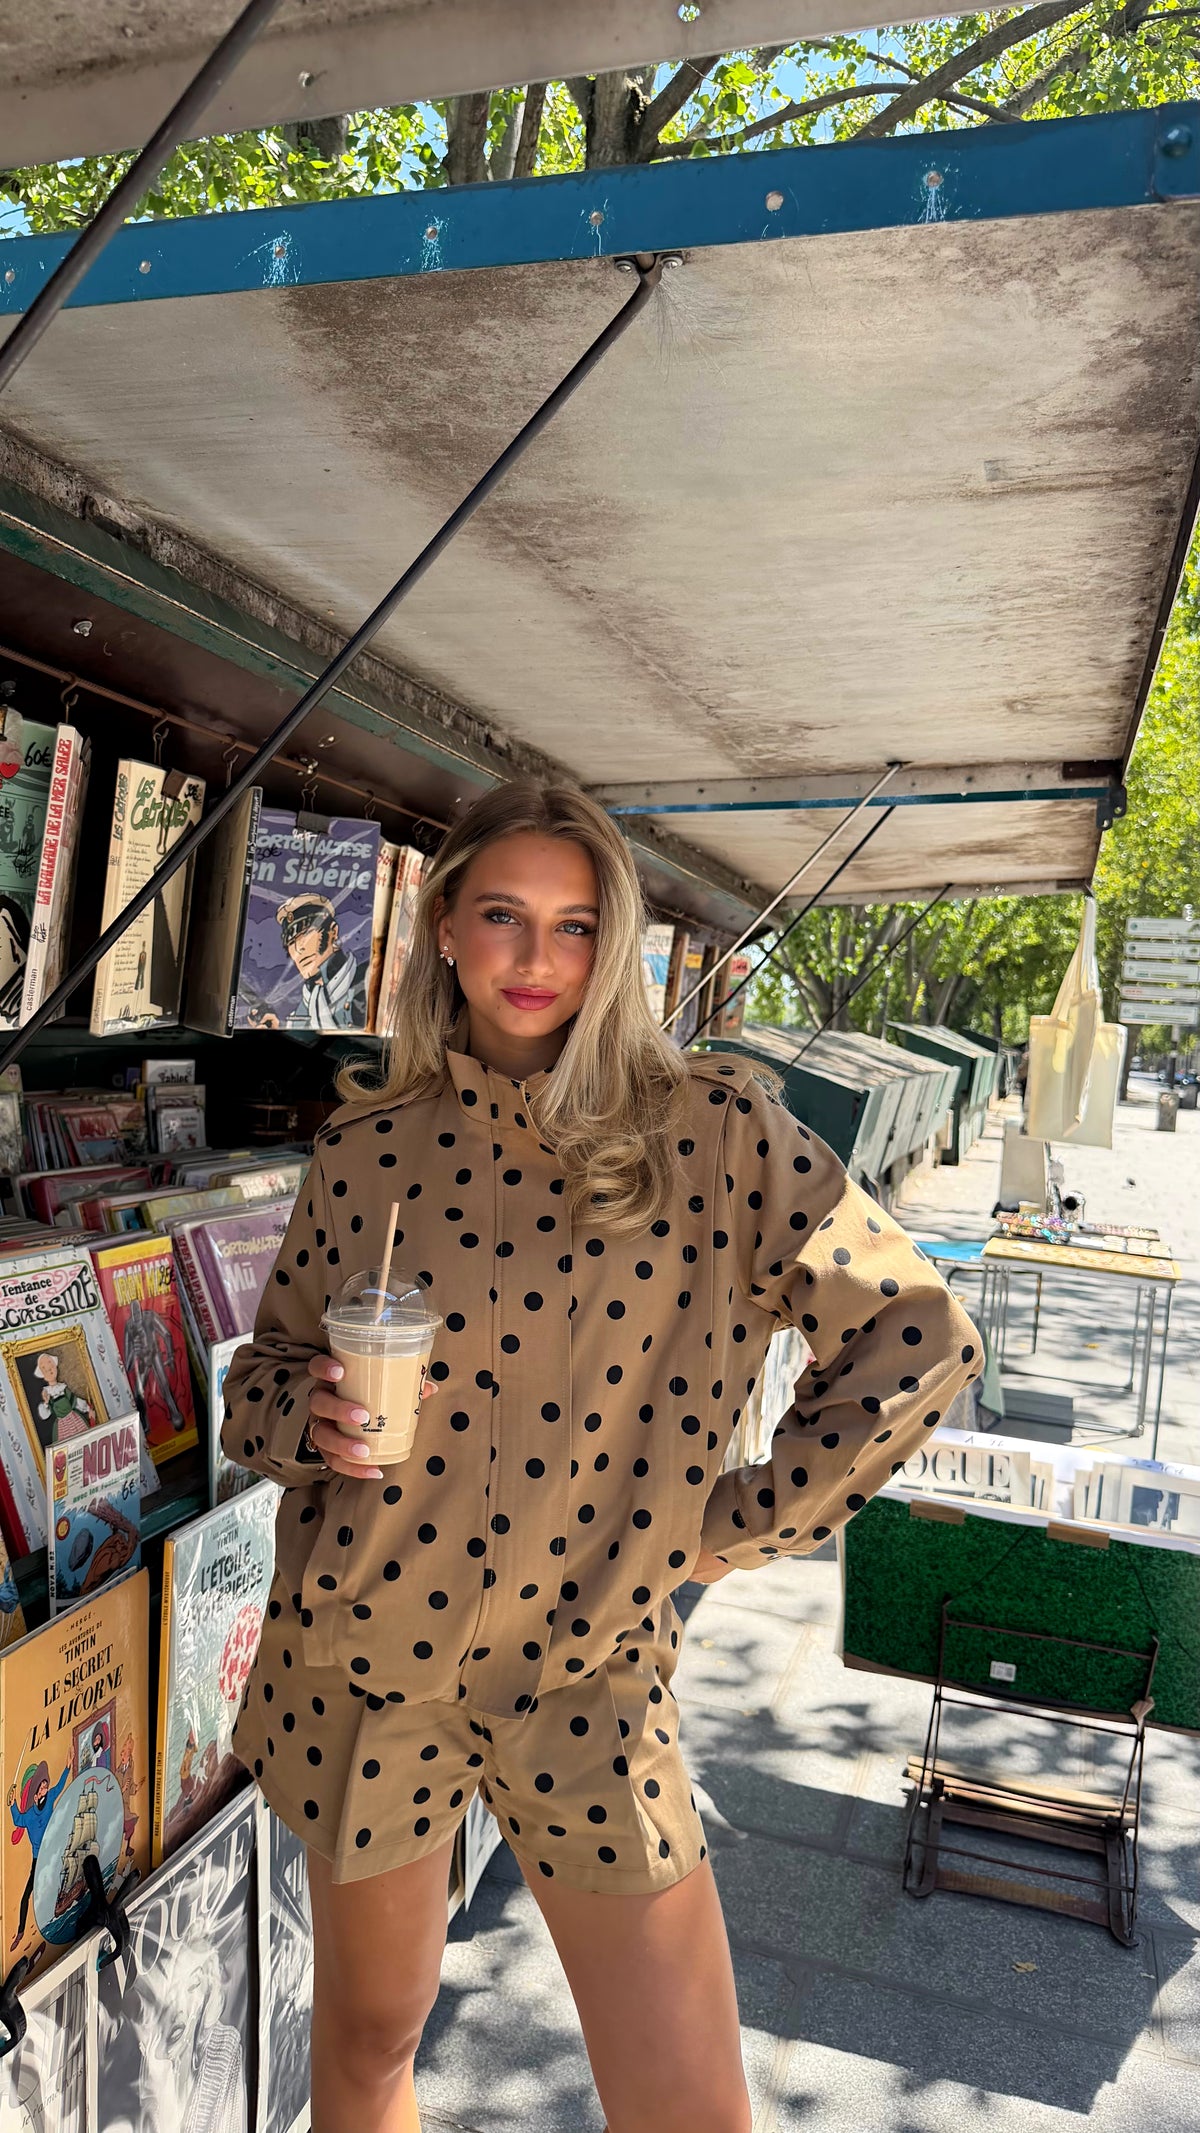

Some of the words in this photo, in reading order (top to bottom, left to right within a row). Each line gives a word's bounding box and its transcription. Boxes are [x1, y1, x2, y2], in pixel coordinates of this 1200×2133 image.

[24, 741, 53, 767] 60€
[51, 778, 67, 802] MER
[49, 803, 64, 819] LA
[46, 820, 62, 836] DE
[299, 835, 373, 858] MALTESE
[39, 838, 59, 889] BALLADE
[282, 858, 373, 890] Sibérie
[37, 890, 51, 905] LA
[26, 968, 38, 1011] casterman
[2, 1277, 52, 1298] l'enfance
[113, 1263, 145, 1308] IRON
[143, 1257, 172, 1299] MAN
[25, 1293, 39, 1306] de
[82, 1425, 139, 1487] NOVA
[899, 1448, 1011, 1488] OGUE
[122, 1478, 137, 1500] 6€
[59, 1643, 68, 1654] LES
[69, 1627, 95, 1647] AVENTURES
[96, 1620, 103, 1628] DE
[65, 1633, 97, 1664] TINTIN
[43, 1680, 61, 1708] LE
[63, 1644, 113, 1694] SECRET
[30, 1716, 51, 1752] LA
[57, 1664, 124, 1732] LICORNE
[108, 1815, 252, 1999] VOGUE
